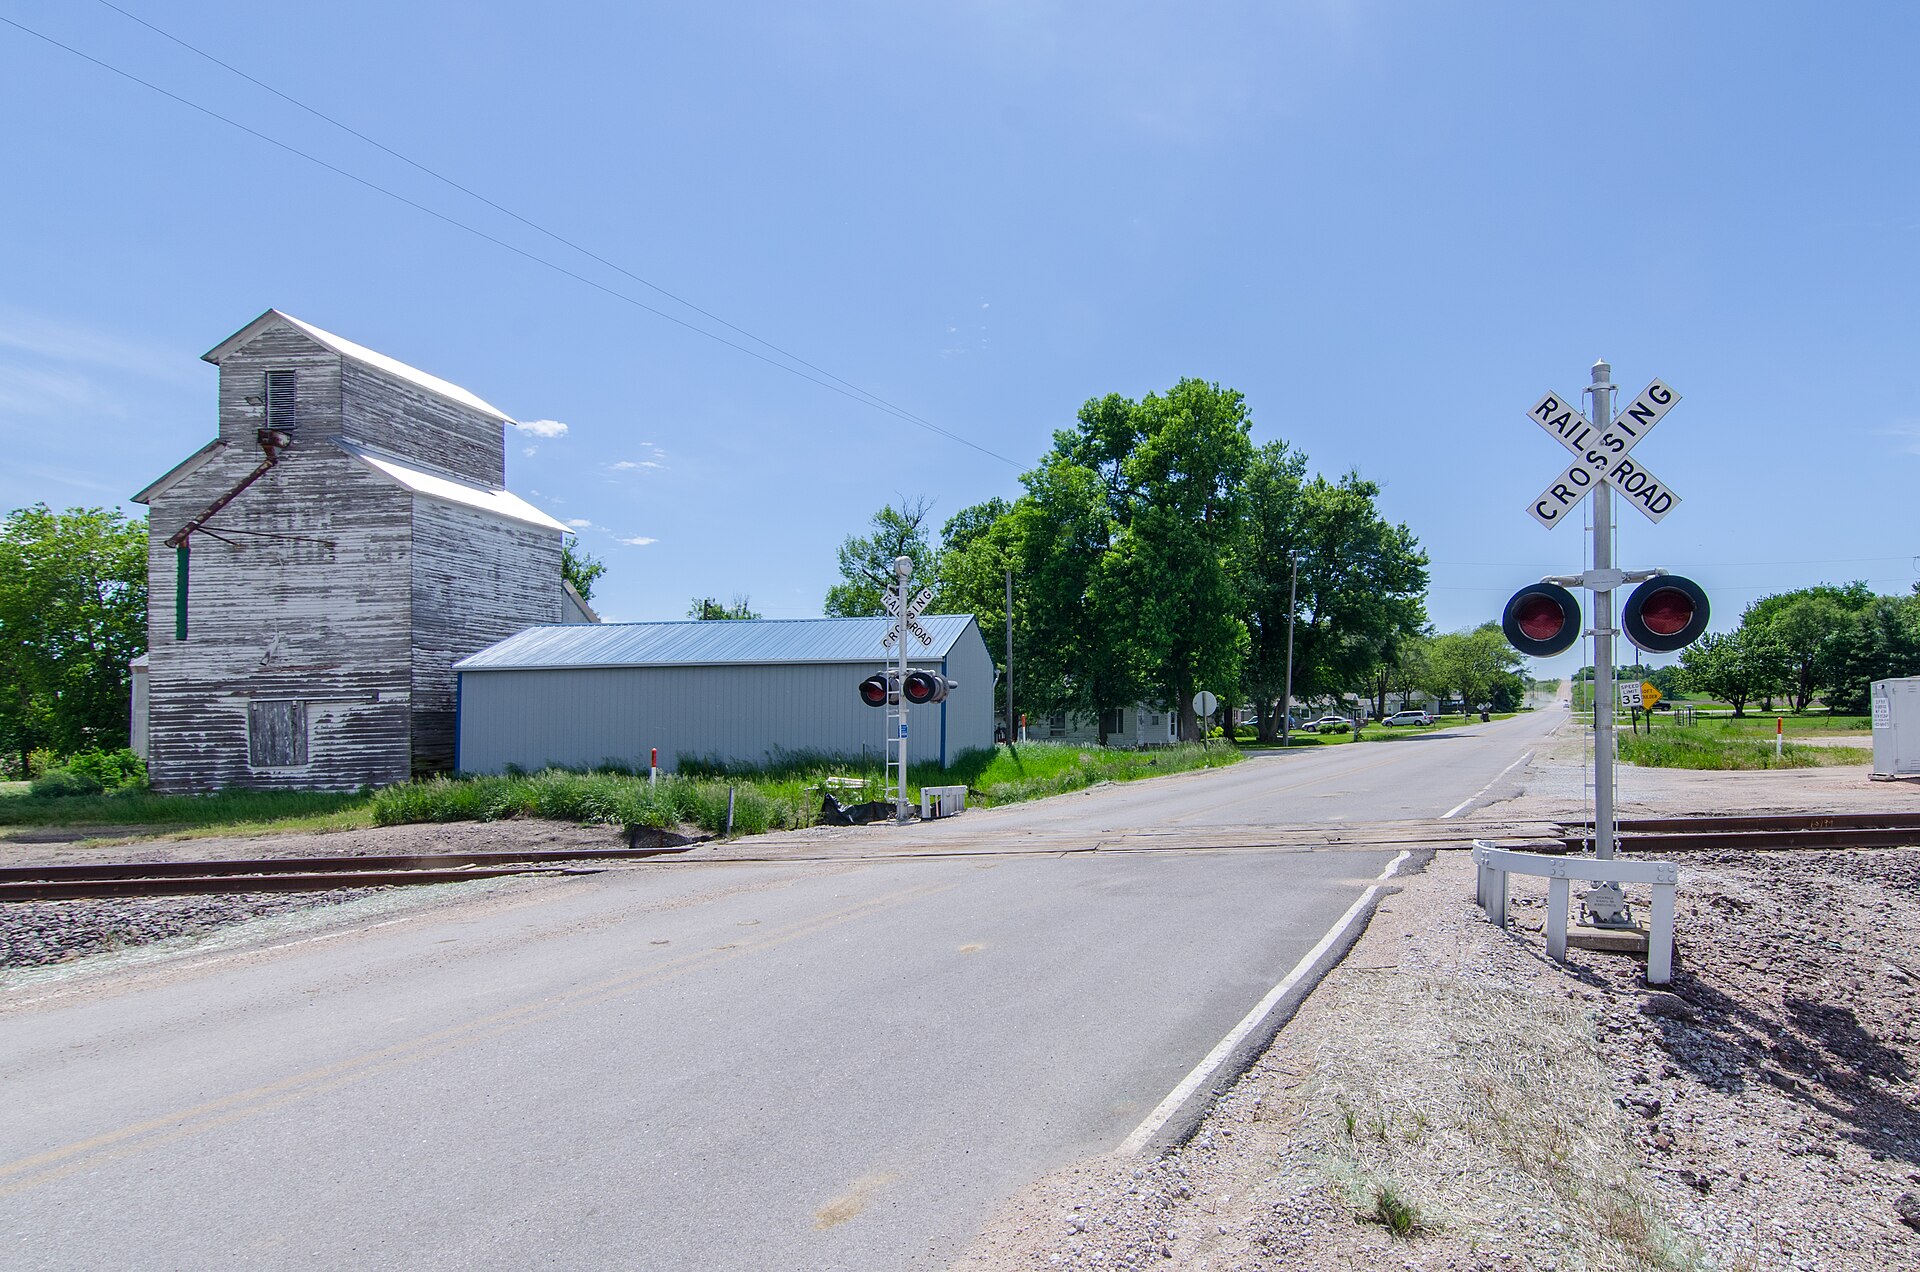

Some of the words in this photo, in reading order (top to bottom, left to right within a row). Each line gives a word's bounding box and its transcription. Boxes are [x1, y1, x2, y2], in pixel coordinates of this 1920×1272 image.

[1534, 396, 1591, 452] RAIL
[1535, 385, 1671, 520] CROSSING
[1609, 459, 1672, 514] ROAD
[909, 621, 932, 646] ROAD
[1622, 694, 1640, 704] 35
